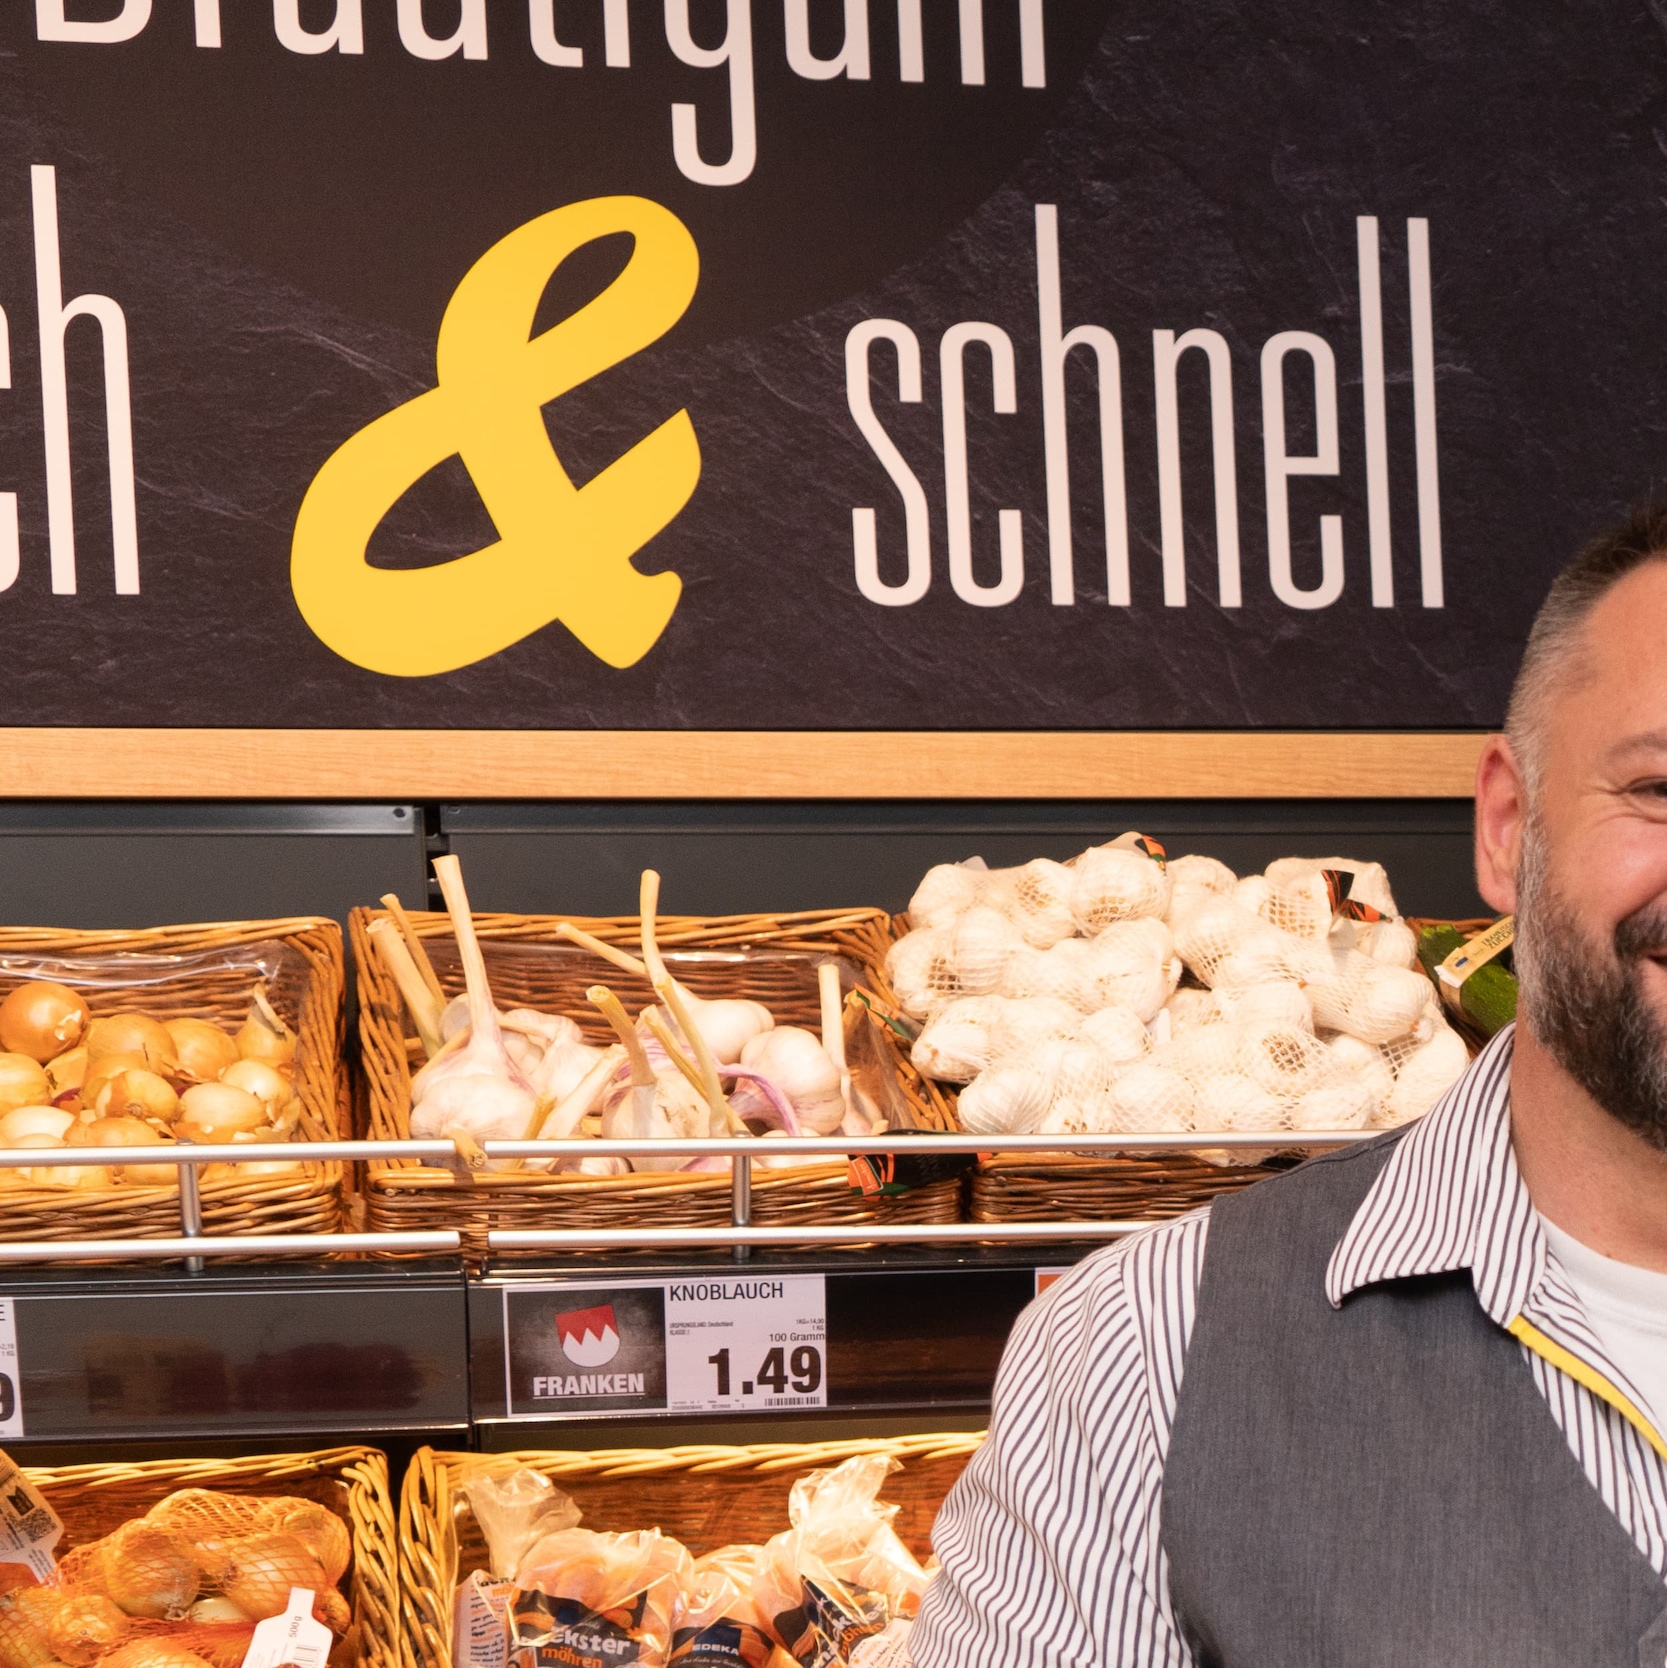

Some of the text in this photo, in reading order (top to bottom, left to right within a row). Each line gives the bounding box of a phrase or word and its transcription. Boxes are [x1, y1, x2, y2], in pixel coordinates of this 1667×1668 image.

[291, 195, 700, 677] &
[846, 204, 1445, 609] schnell
[670, 1282, 783, 1301] KNOBLAUCH
[769, 1332, 825, 1342] 100 Gramm
[708, 1345, 821, 1396] 1.49
[533, 1373, 645, 1397] FRANKEN
[691, 1643, 739, 1656] EDEKA
